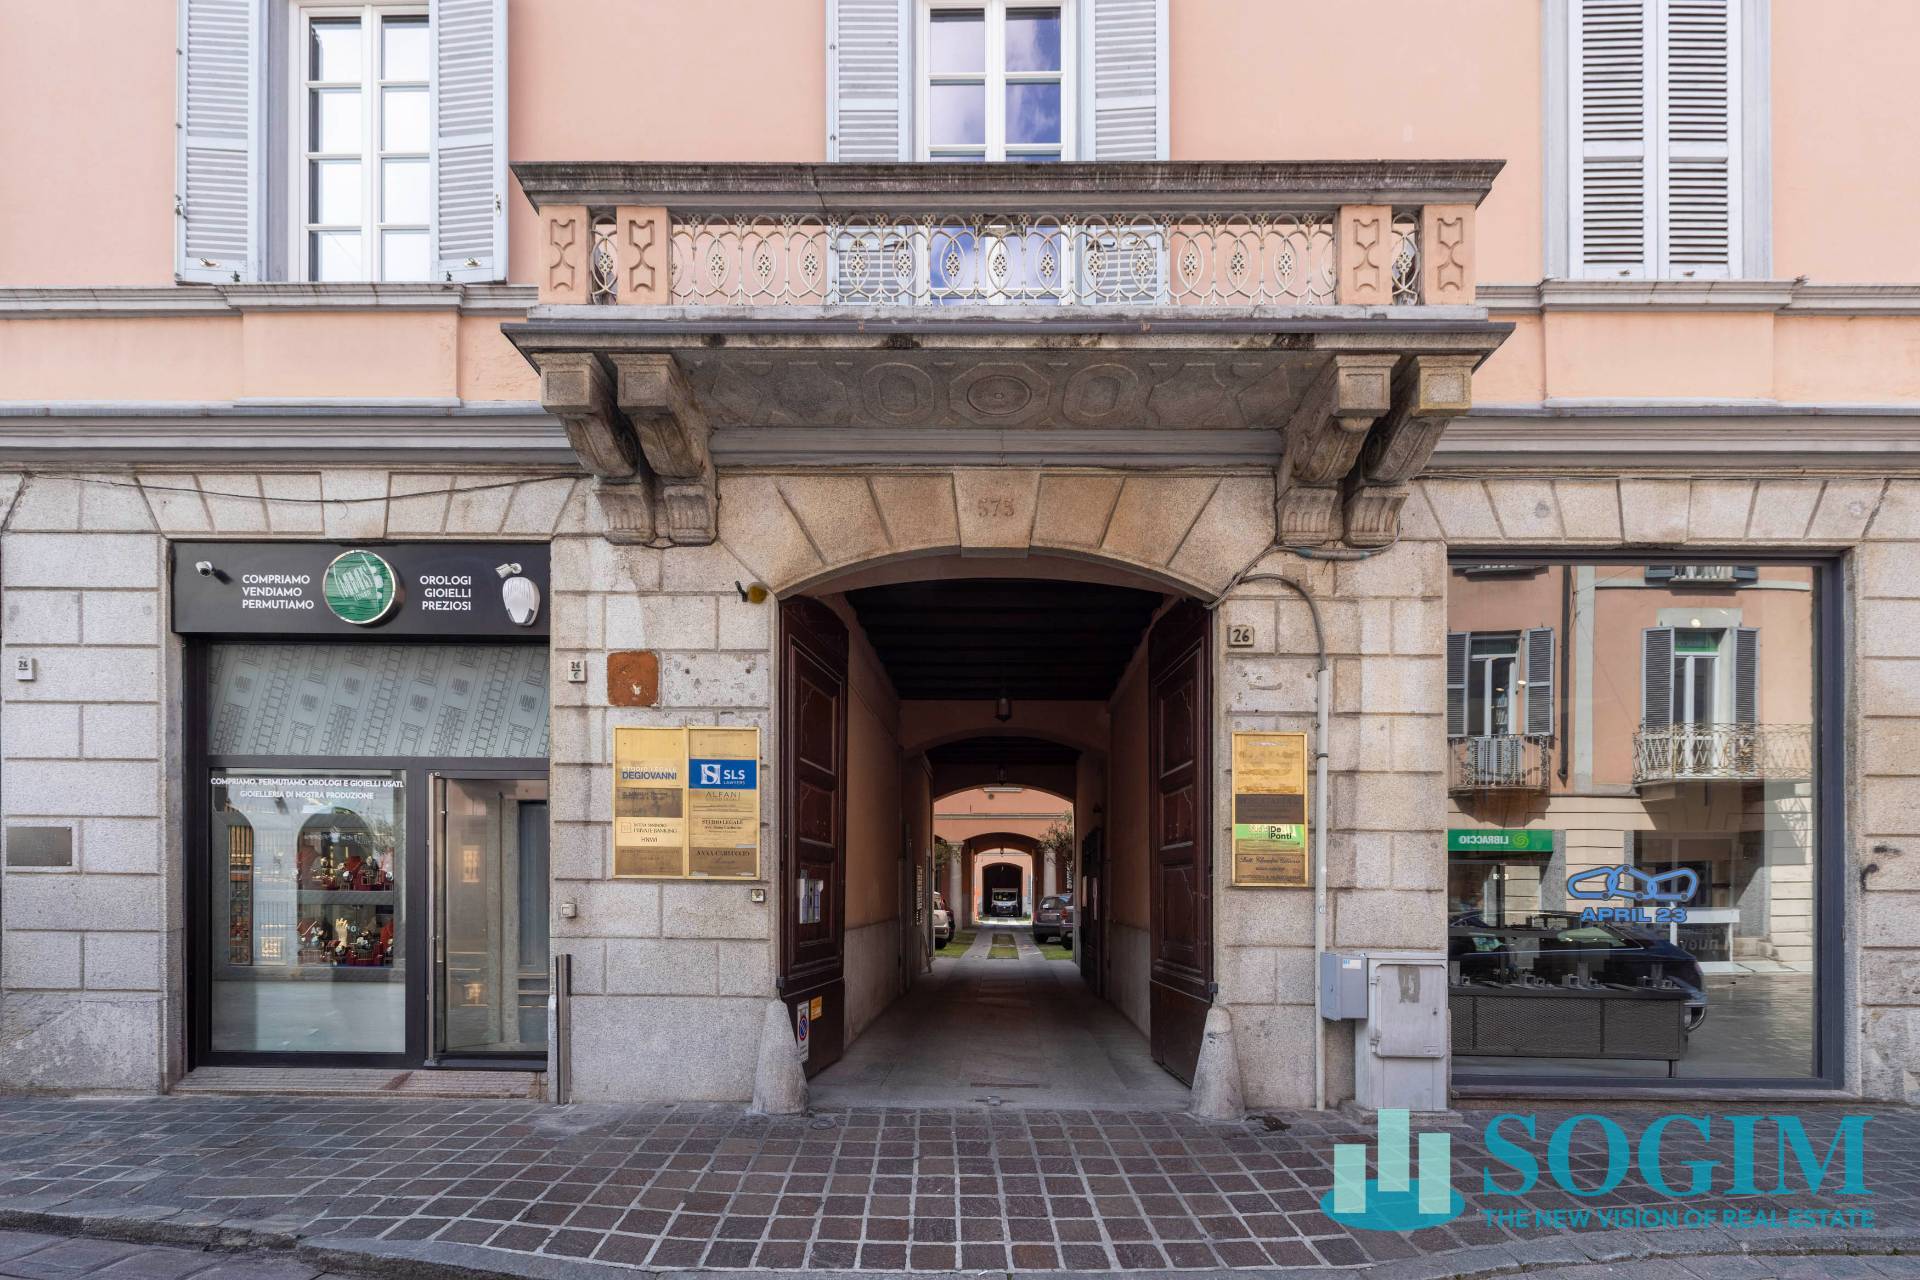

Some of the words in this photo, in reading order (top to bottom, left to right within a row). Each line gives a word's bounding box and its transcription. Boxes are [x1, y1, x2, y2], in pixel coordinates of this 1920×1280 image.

[242, 574, 311, 585] COMPRIAMO
[419, 575, 472, 585] OROLOGI
[242, 587, 303, 597] VENDIAMO
[424, 588, 472, 598] GIOIELLI
[242, 600, 315, 610] PERMUTIAMO
[421, 601, 472, 611] PREZIOSI
[1233, 628, 1250, 642] 26
[622, 771, 677, 781] DEGIOVANNI
[723, 769, 746, 780] SLS
[258, 778, 306, 786] PERMUTIAMO
[308, 779, 342, 787] OROLOGI
[350, 780, 381, 788] GIOIELLI
[240, 790, 284, 799] GIOIELLERIA
[286, 790, 294, 799] DI
[296, 791, 324, 799] NOSTRA
[326, 791, 374, 800] PRODUZIONE
[1270, 832, 1292, 840] Ponti
[1581, 907, 1652, 923] APRIL
[1656, 907, 1687, 923] 23
